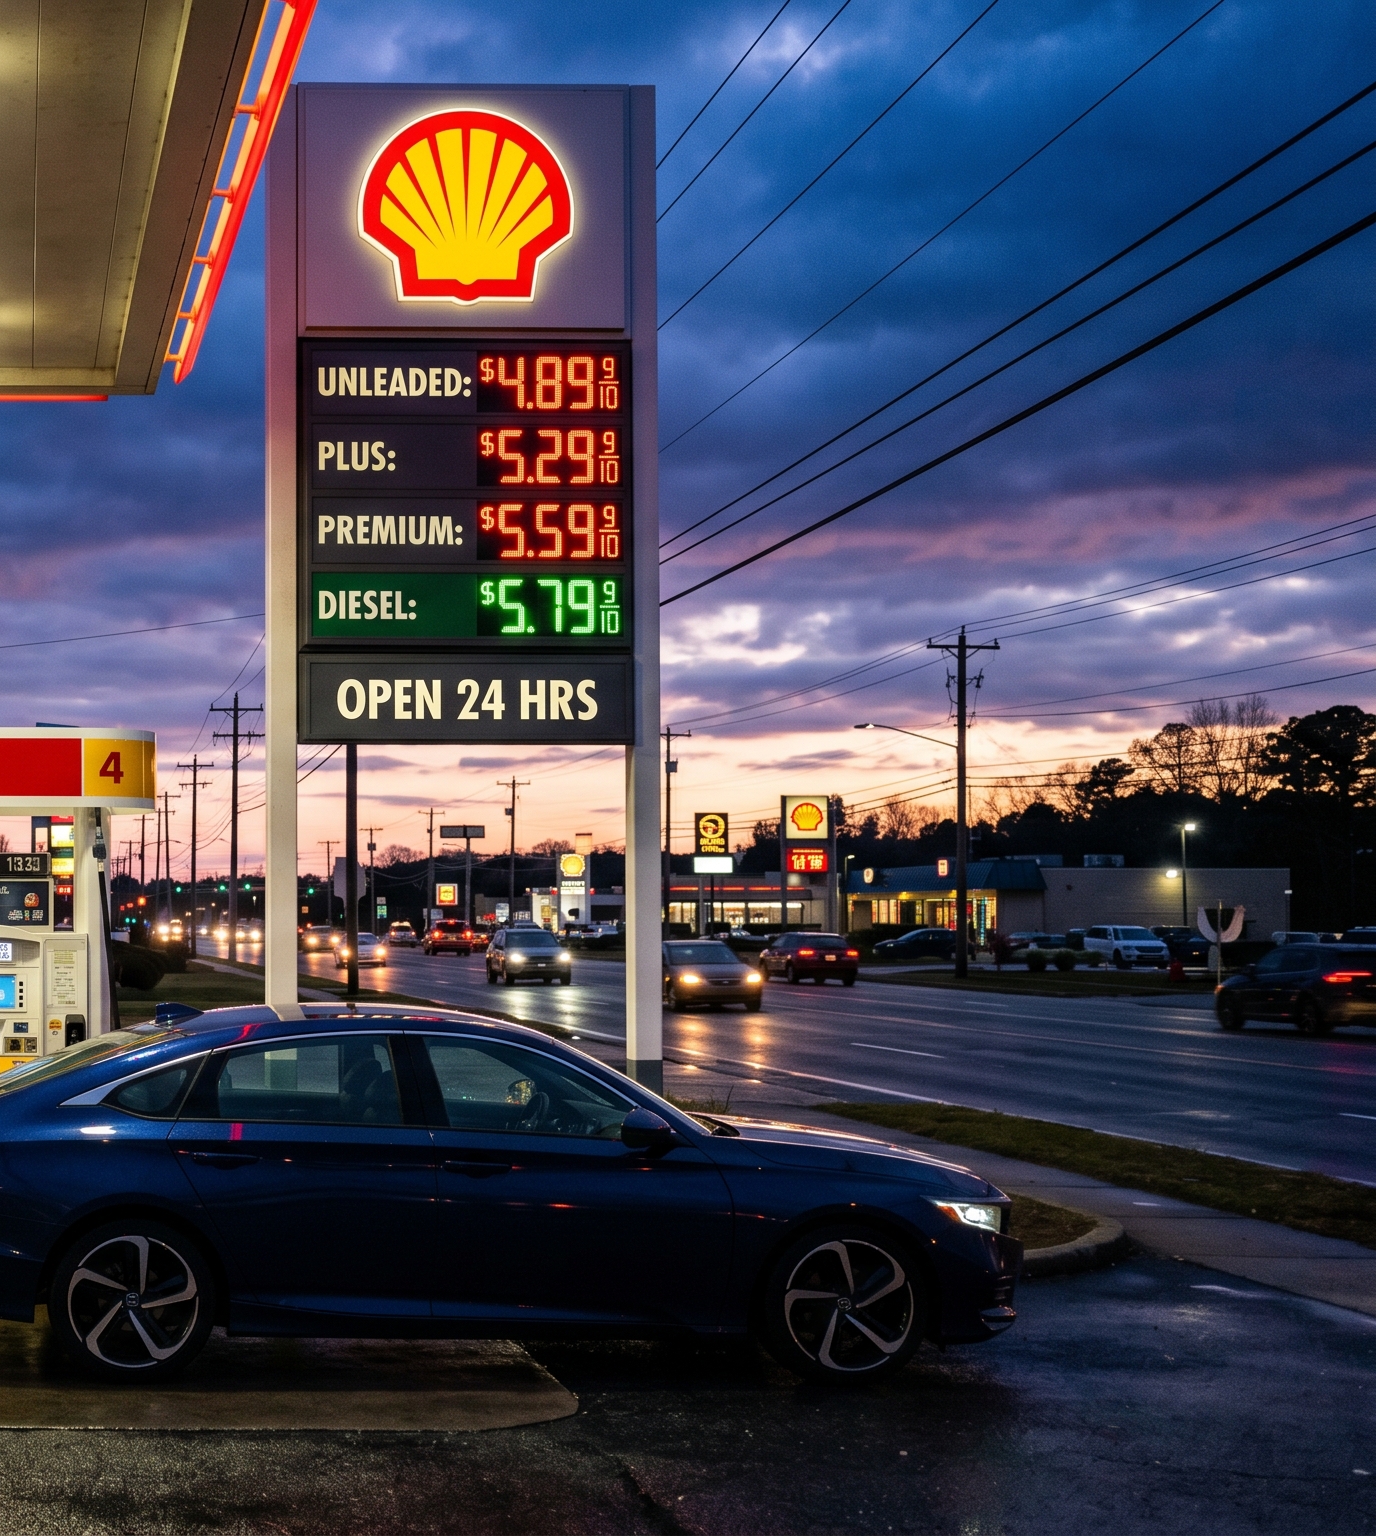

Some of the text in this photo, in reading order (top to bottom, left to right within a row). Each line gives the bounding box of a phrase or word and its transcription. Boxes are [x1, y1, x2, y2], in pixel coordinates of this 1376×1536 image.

[318, 367, 472, 398] UNLEADED:
[480, 356, 594, 410] $4.89
[318, 441, 396, 472] PLUS:
[480, 429, 594, 484] $5.29
[318, 515, 463, 546] PREMIUM:
[480, 503, 595, 558] $5.59
[318, 590, 417, 620] DIESEL:
[480, 578, 595, 634] $5.79
[336, 678, 598, 721] OPEN 24 HRS
[99, 751, 124, 784] 4
